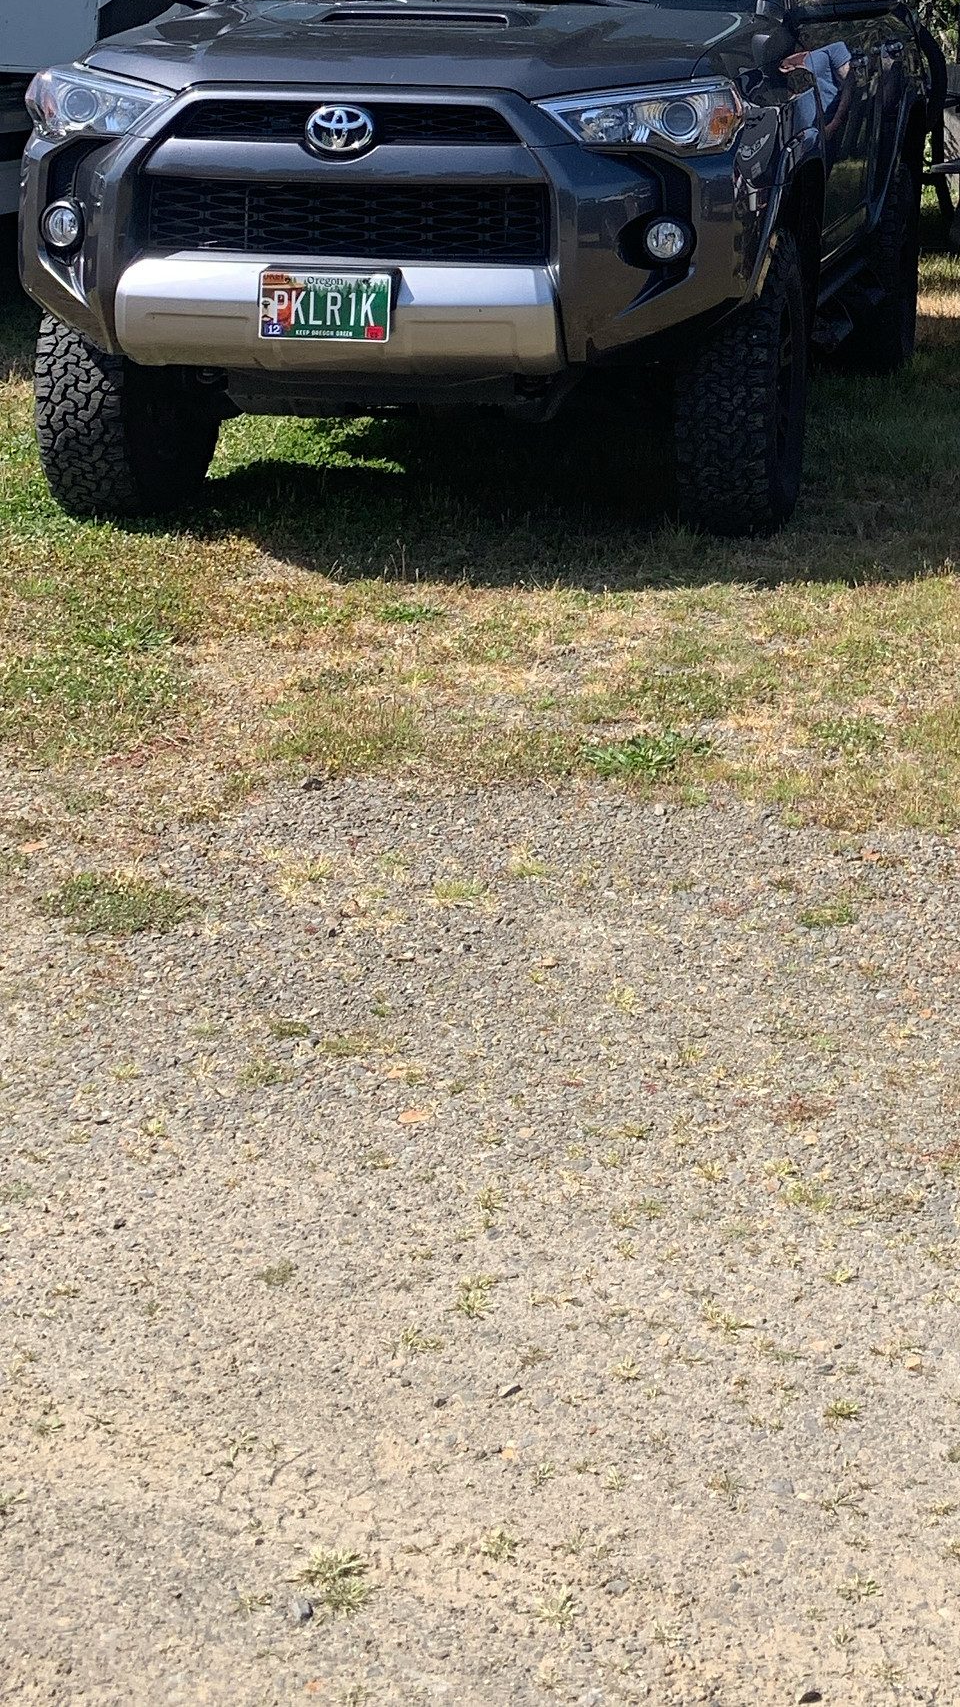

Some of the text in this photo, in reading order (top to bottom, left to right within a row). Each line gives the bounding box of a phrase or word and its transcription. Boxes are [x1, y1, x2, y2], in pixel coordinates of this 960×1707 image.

[307, 276, 344, 287] Oregon
[273, 290, 376, 326] PKLR1K
[268, 324, 280, 335] 12
